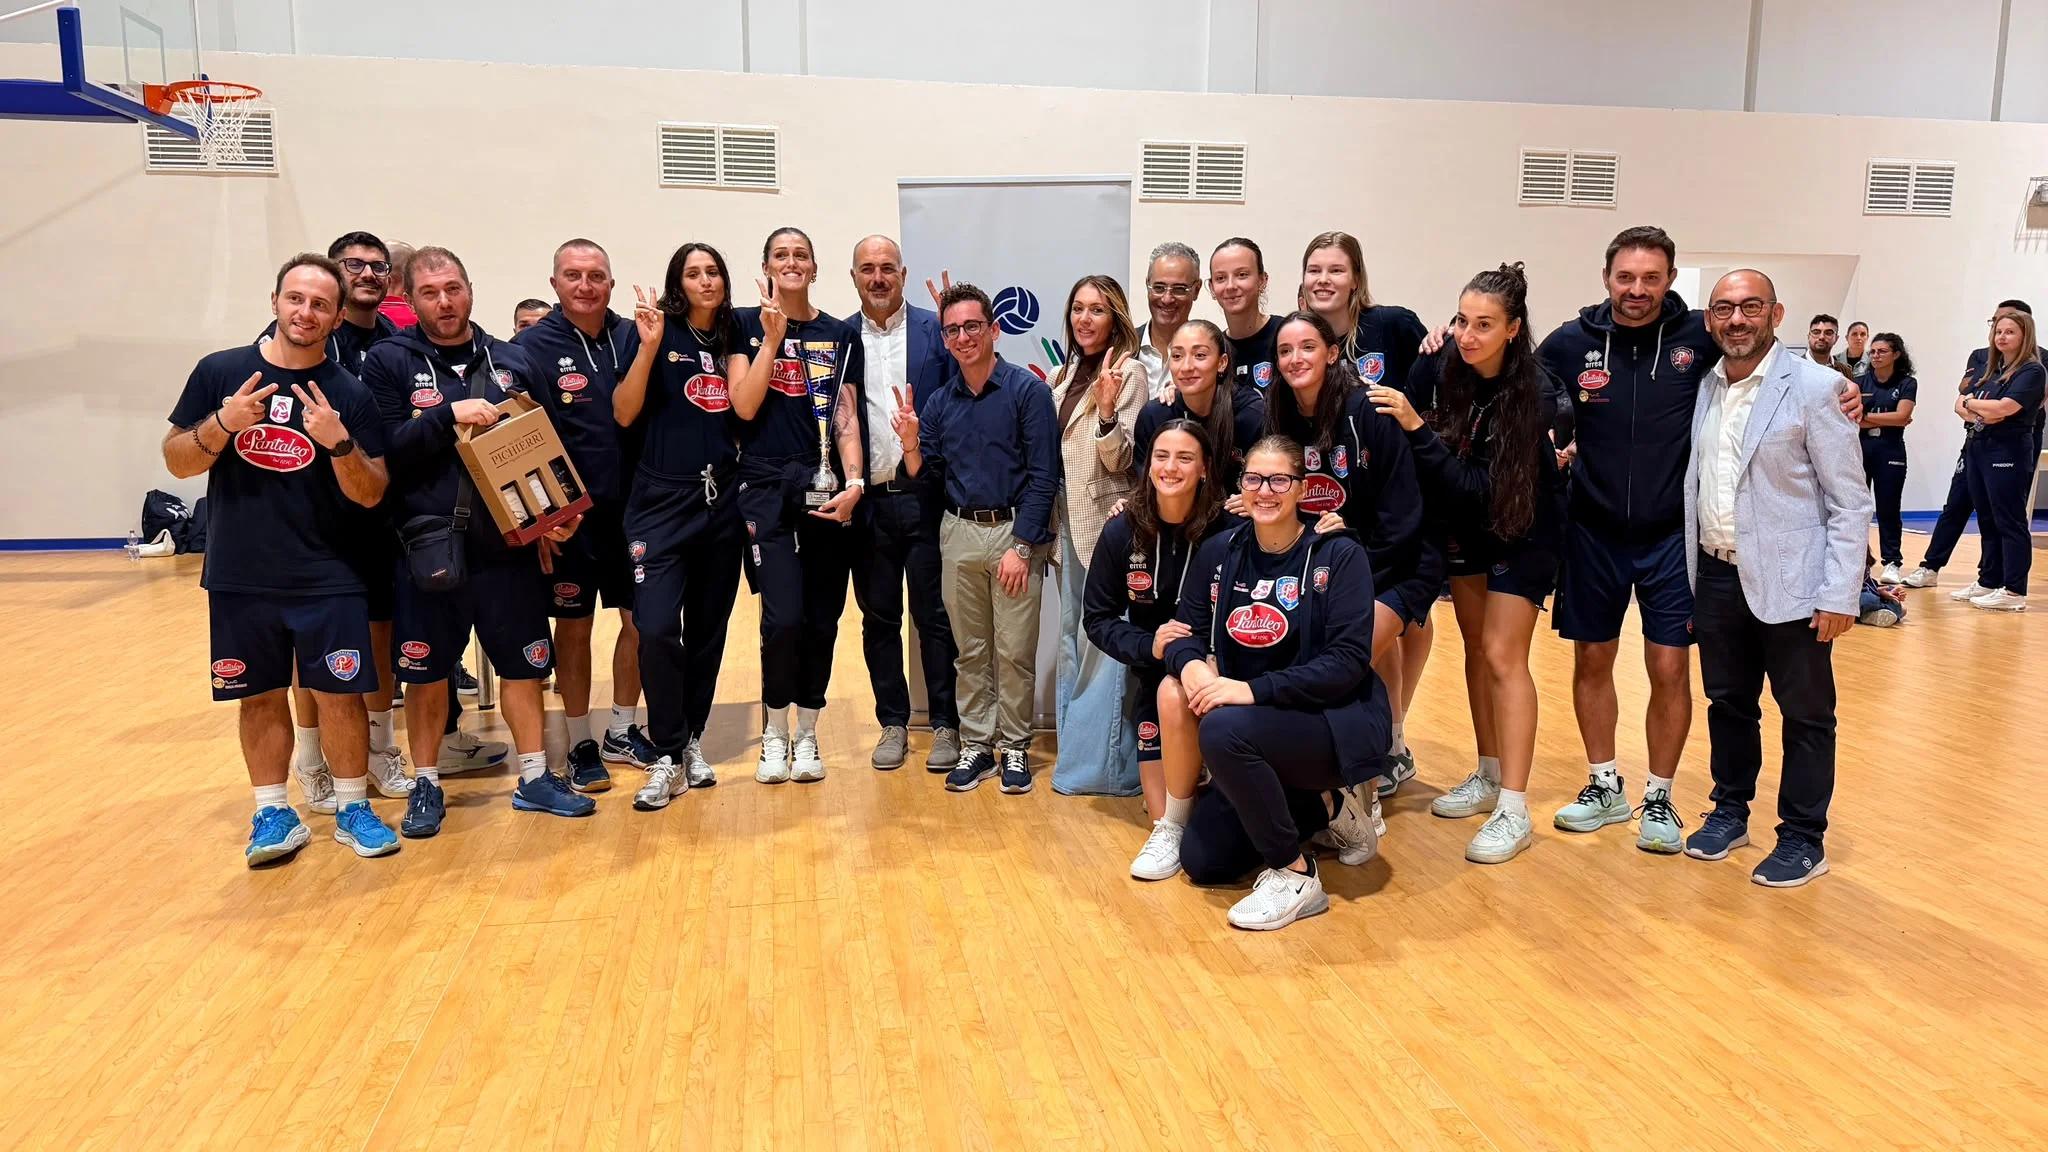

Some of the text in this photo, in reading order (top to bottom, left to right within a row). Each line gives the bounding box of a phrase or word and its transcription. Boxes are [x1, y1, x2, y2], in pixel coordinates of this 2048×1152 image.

[773, 361, 804, 384] Panta
[690, 377, 728, 400] Pantale
[241, 427, 309, 461] Pantaleo
[491, 432, 544, 465] PICHERRI
[1231, 608, 1282, 637] Pantaleo
